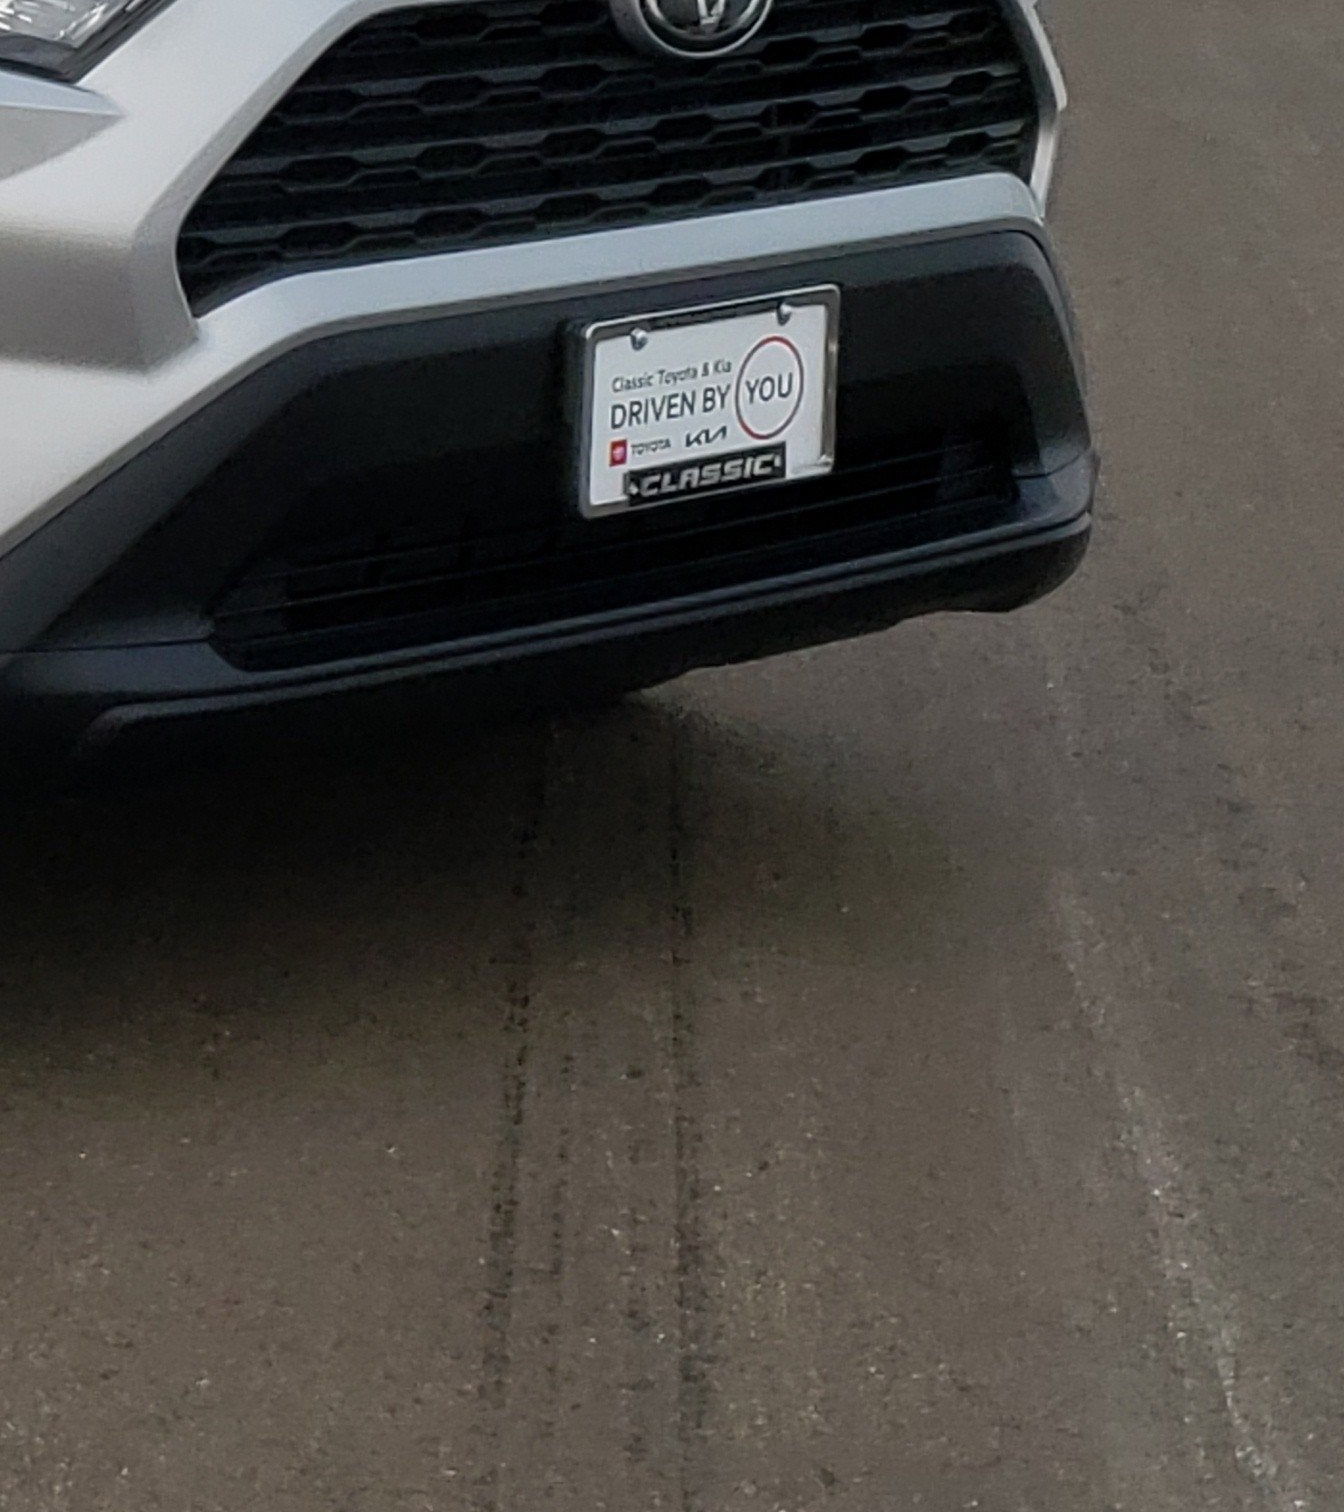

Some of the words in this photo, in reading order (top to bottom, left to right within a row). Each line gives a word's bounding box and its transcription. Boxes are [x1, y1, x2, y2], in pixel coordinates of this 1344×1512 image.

[612, 371, 654, 393] Classic
[657, 367, 698, 386] Toyota
[713, 358, 732, 374] Kia
[610, 390, 697, 430] DRIVEN
[702, 383, 732, 413] BY
[745, 372, 794, 405] YOU
[631, 438, 672, 455] TOYOTA
[639, 453, 775, 498] CLASSIC
